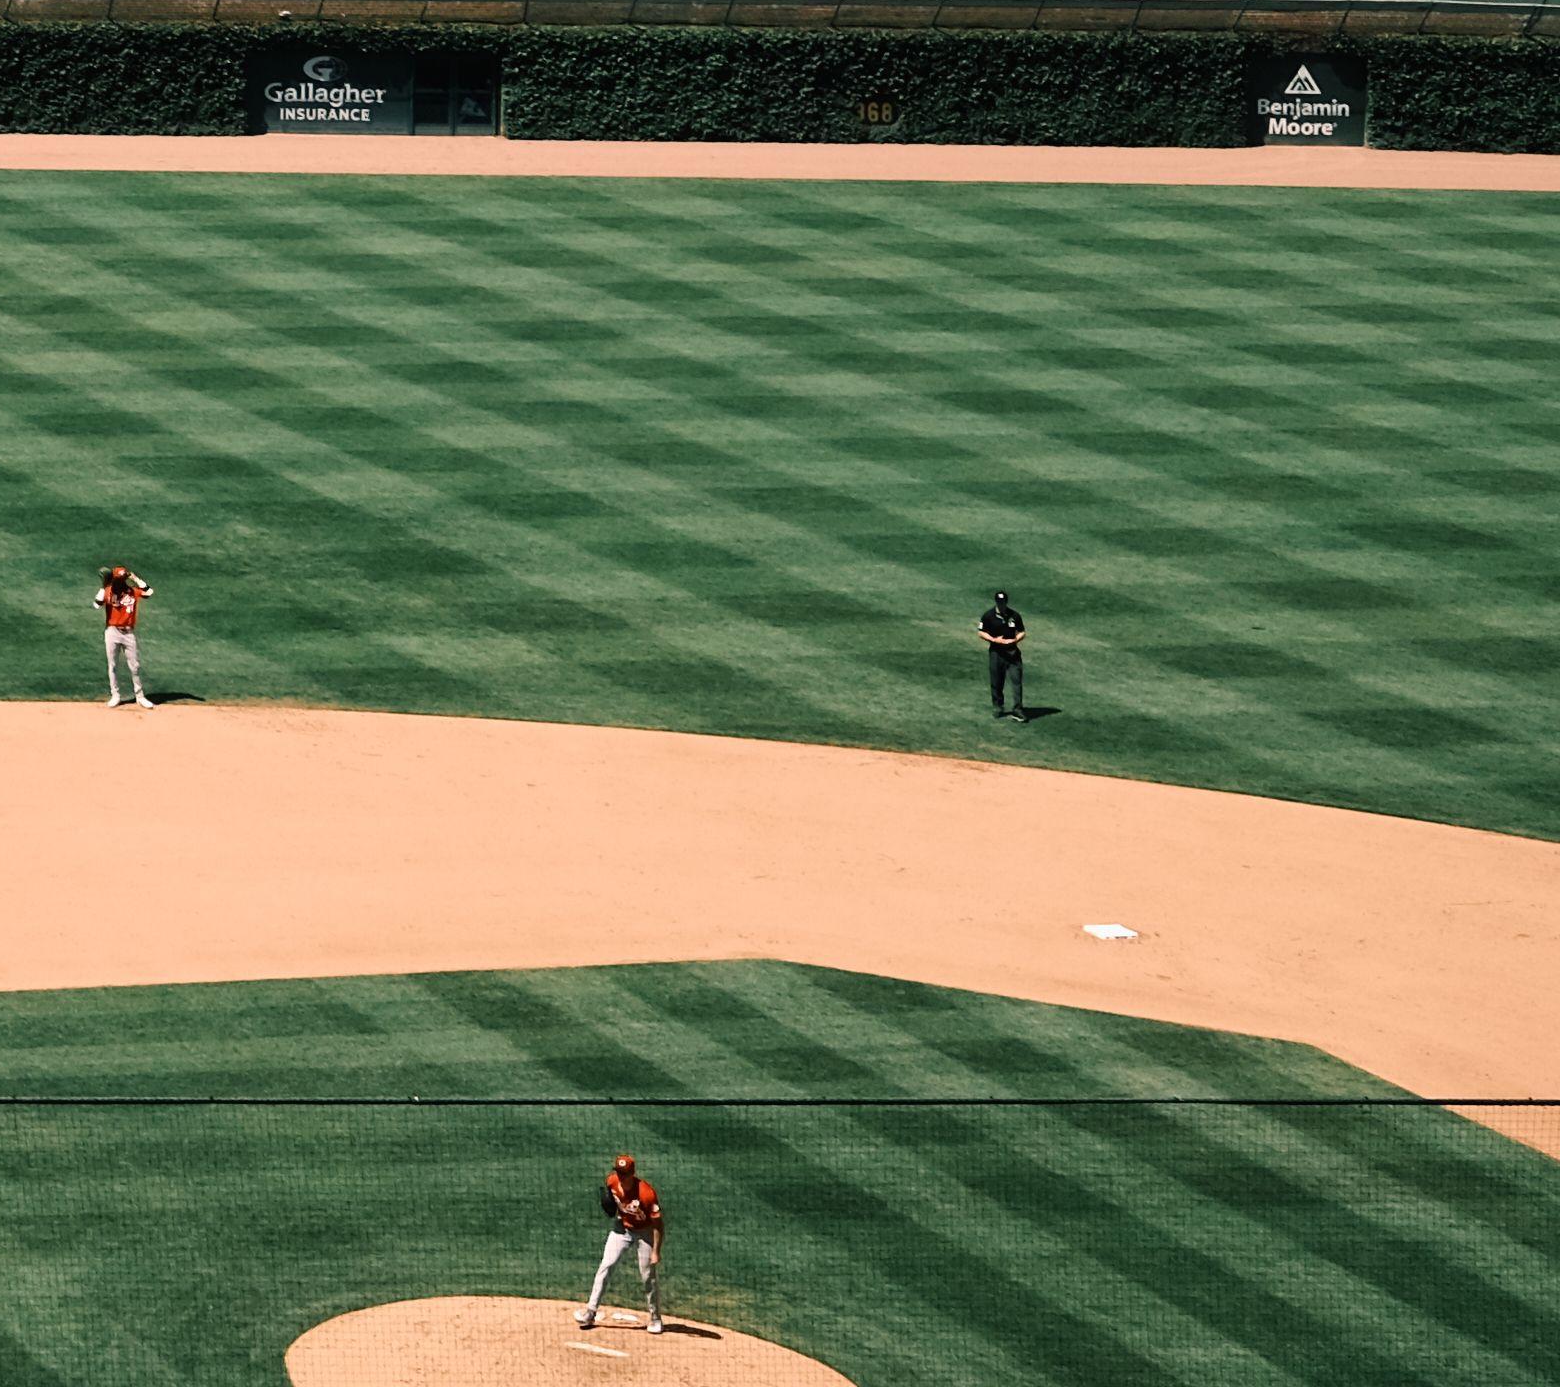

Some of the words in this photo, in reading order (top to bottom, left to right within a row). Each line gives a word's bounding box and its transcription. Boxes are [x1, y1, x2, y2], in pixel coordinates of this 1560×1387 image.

[264, 82, 386, 108] Gallagher
[279, 108, 371, 122] INSURANCE
[1257, 98, 1350, 121] Benjamin
[1268, 116, 1334, 137] Moore
